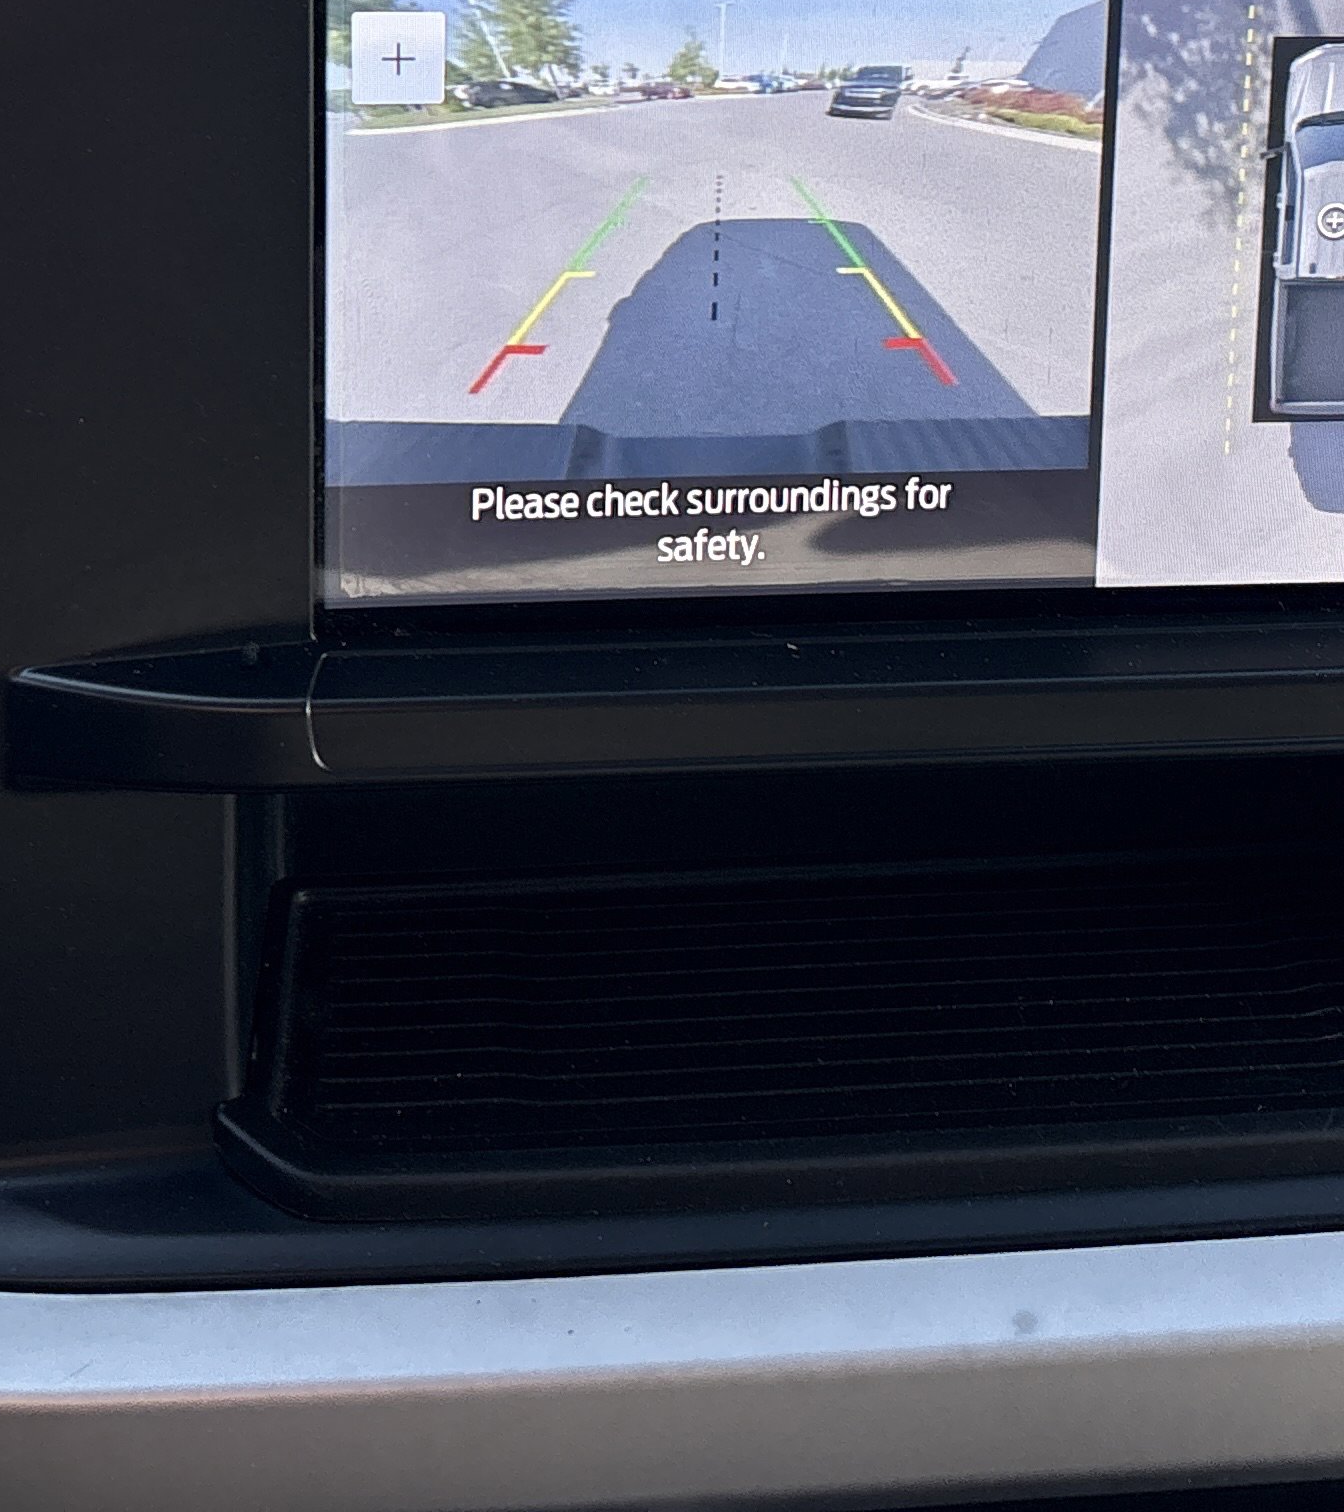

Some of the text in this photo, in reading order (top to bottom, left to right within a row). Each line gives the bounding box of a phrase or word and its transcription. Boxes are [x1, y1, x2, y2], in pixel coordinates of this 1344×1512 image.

[471, 477, 952, 521] Please check surroundings for
[657, 528, 766, 565] safety.
